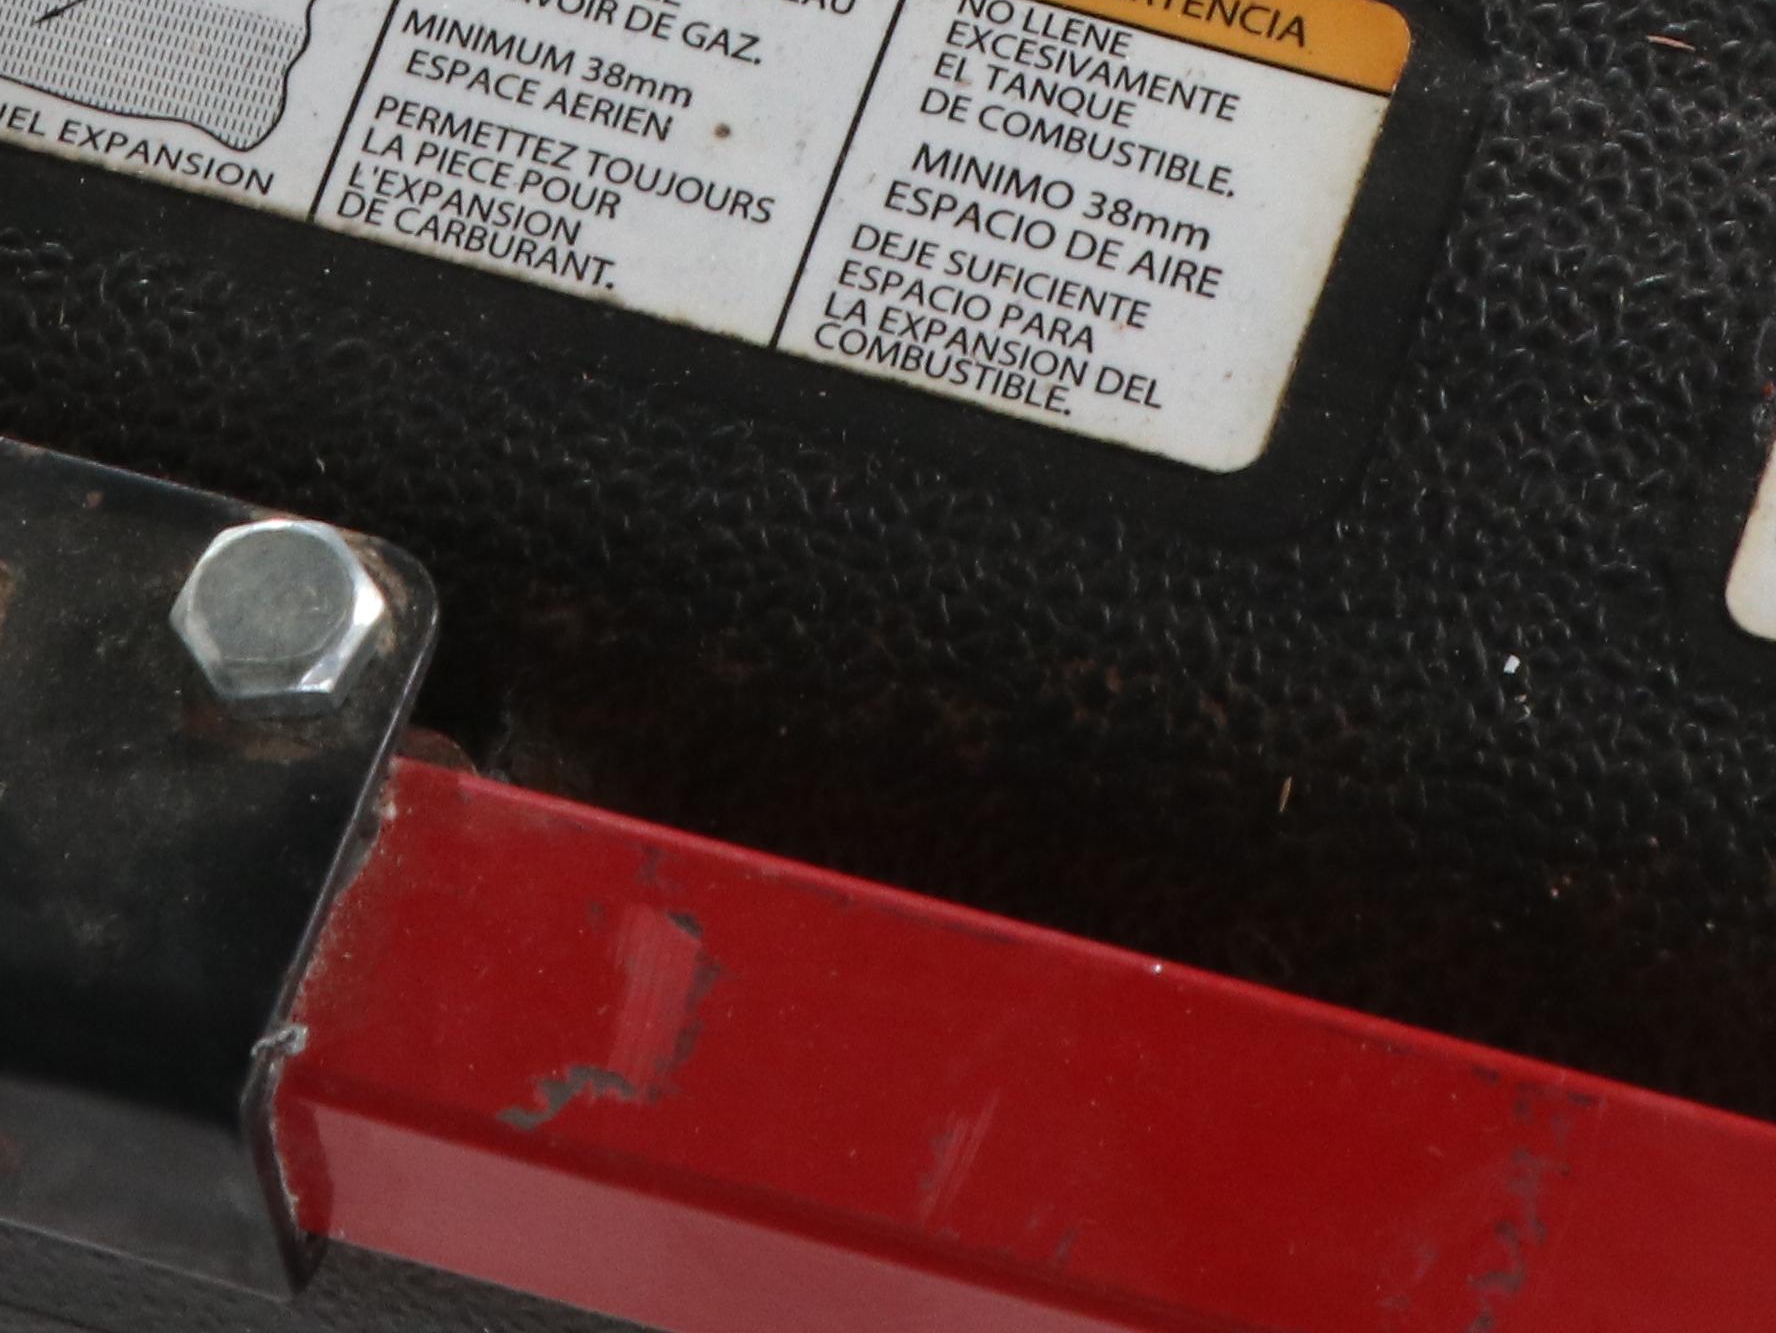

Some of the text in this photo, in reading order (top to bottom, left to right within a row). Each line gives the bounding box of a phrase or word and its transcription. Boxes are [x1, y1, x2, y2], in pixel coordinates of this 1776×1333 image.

[401, 8, 692, 108] MINIMUM 38mm
[623, 4, 676, 40] DE
[681, 21, 761, 65] GAZ.
[945, 19, 1240, 121] EXCESIVAMENTE
[1021, 6, 1132, 58] LLENE
[405, 48, 673, 141] ESPACE AERIEN
[933, 51, 1135, 128] EL TANQUE
[56, 118, 274, 195] EXPANSION
[360, 127, 621, 219] LA PIECE POUR
[373, 95, 775, 223] PERMETTEZ TOUJOURS
[919, 87, 1234, 197] DE COMBUSTIBLE.
[336, 190, 615, 290] DE CARBURANT.
[347, 161, 581, 246] L'EXPANSION
[883, 179, 1222, 298] ESPACIO DE AIRE
[911, 142, 1210, 251] MINIMO 38mm
[837, 258, 1093, 354] ESPACIO PARA
[850, 222, 1150, 329] DEJE SUFICIENTE
[813, 322, 1071, 416] COMBUSTIBLE.
[823, 291, 1161, 409] LA EXPANSION DEL
